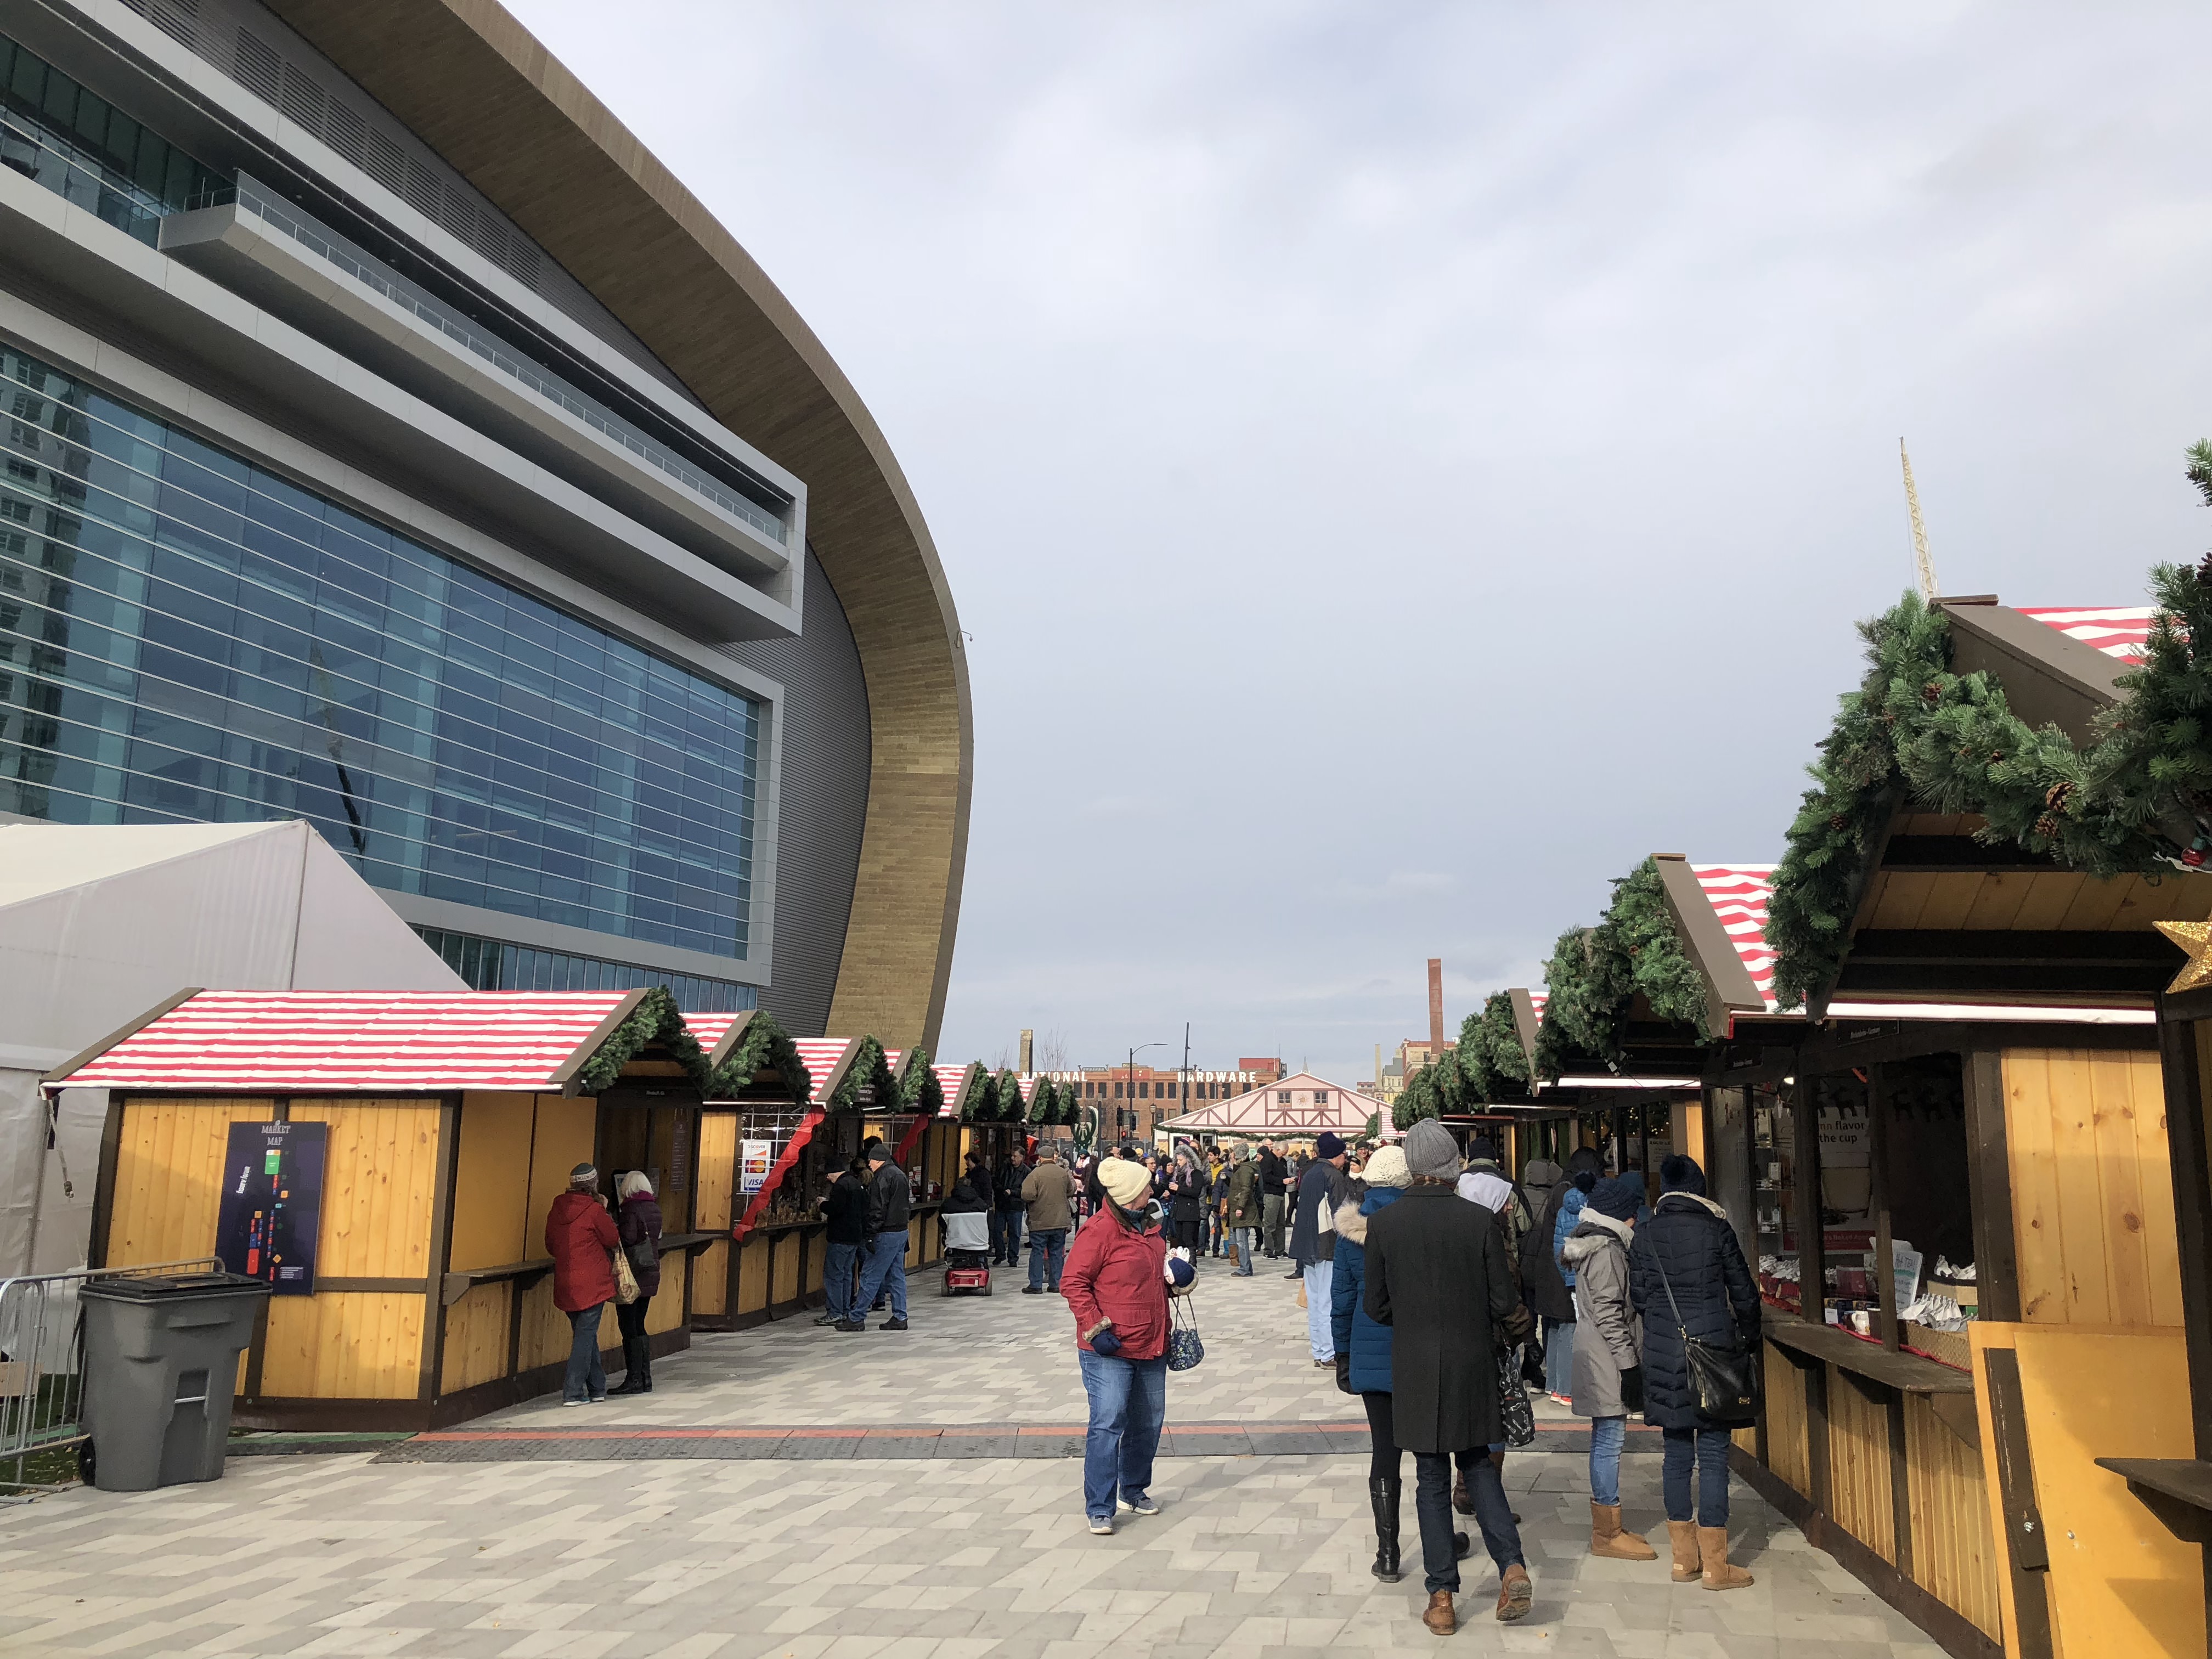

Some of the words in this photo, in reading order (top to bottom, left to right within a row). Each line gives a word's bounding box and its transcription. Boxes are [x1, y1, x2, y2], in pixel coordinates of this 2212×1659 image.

[1022, 1071, 1088, 1082] NATIONAL
[1177, 1071, 1256, 1082] HARDWARE
[261, 1125, 291, 1134] MARKET
[1836, 1120, 1865, 1130] flavor
[267, 1137, 283, 1146] MAP
[1819, 1134, 1836, 1142] the
[1839, 1135, 1858, 1144] cup
